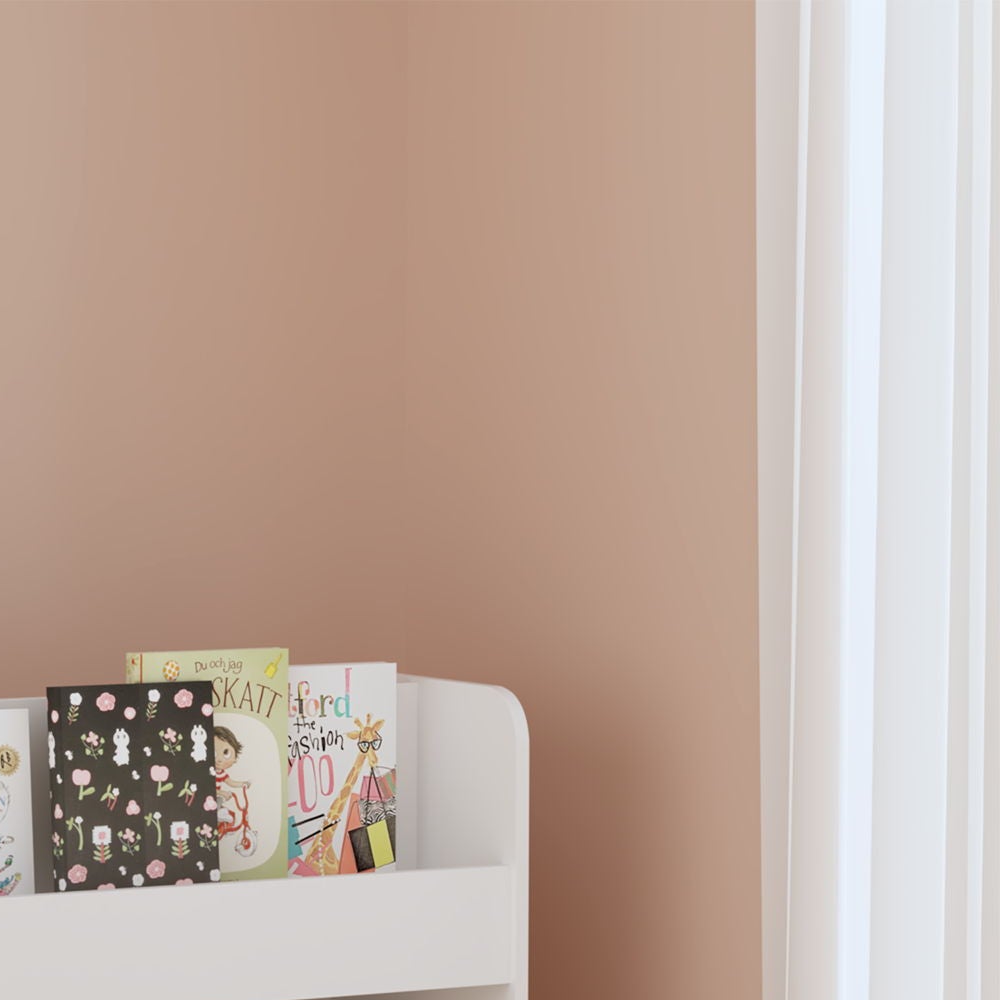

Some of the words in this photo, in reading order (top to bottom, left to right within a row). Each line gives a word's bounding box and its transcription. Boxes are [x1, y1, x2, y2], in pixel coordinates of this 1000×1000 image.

[194, 661, 208, 673] Du
[209, 657, 226, 669] och
[223, 659, 243, 674] jag
[211, 676, 283, 719] SKATT
[293, 715, 316, 734] the
